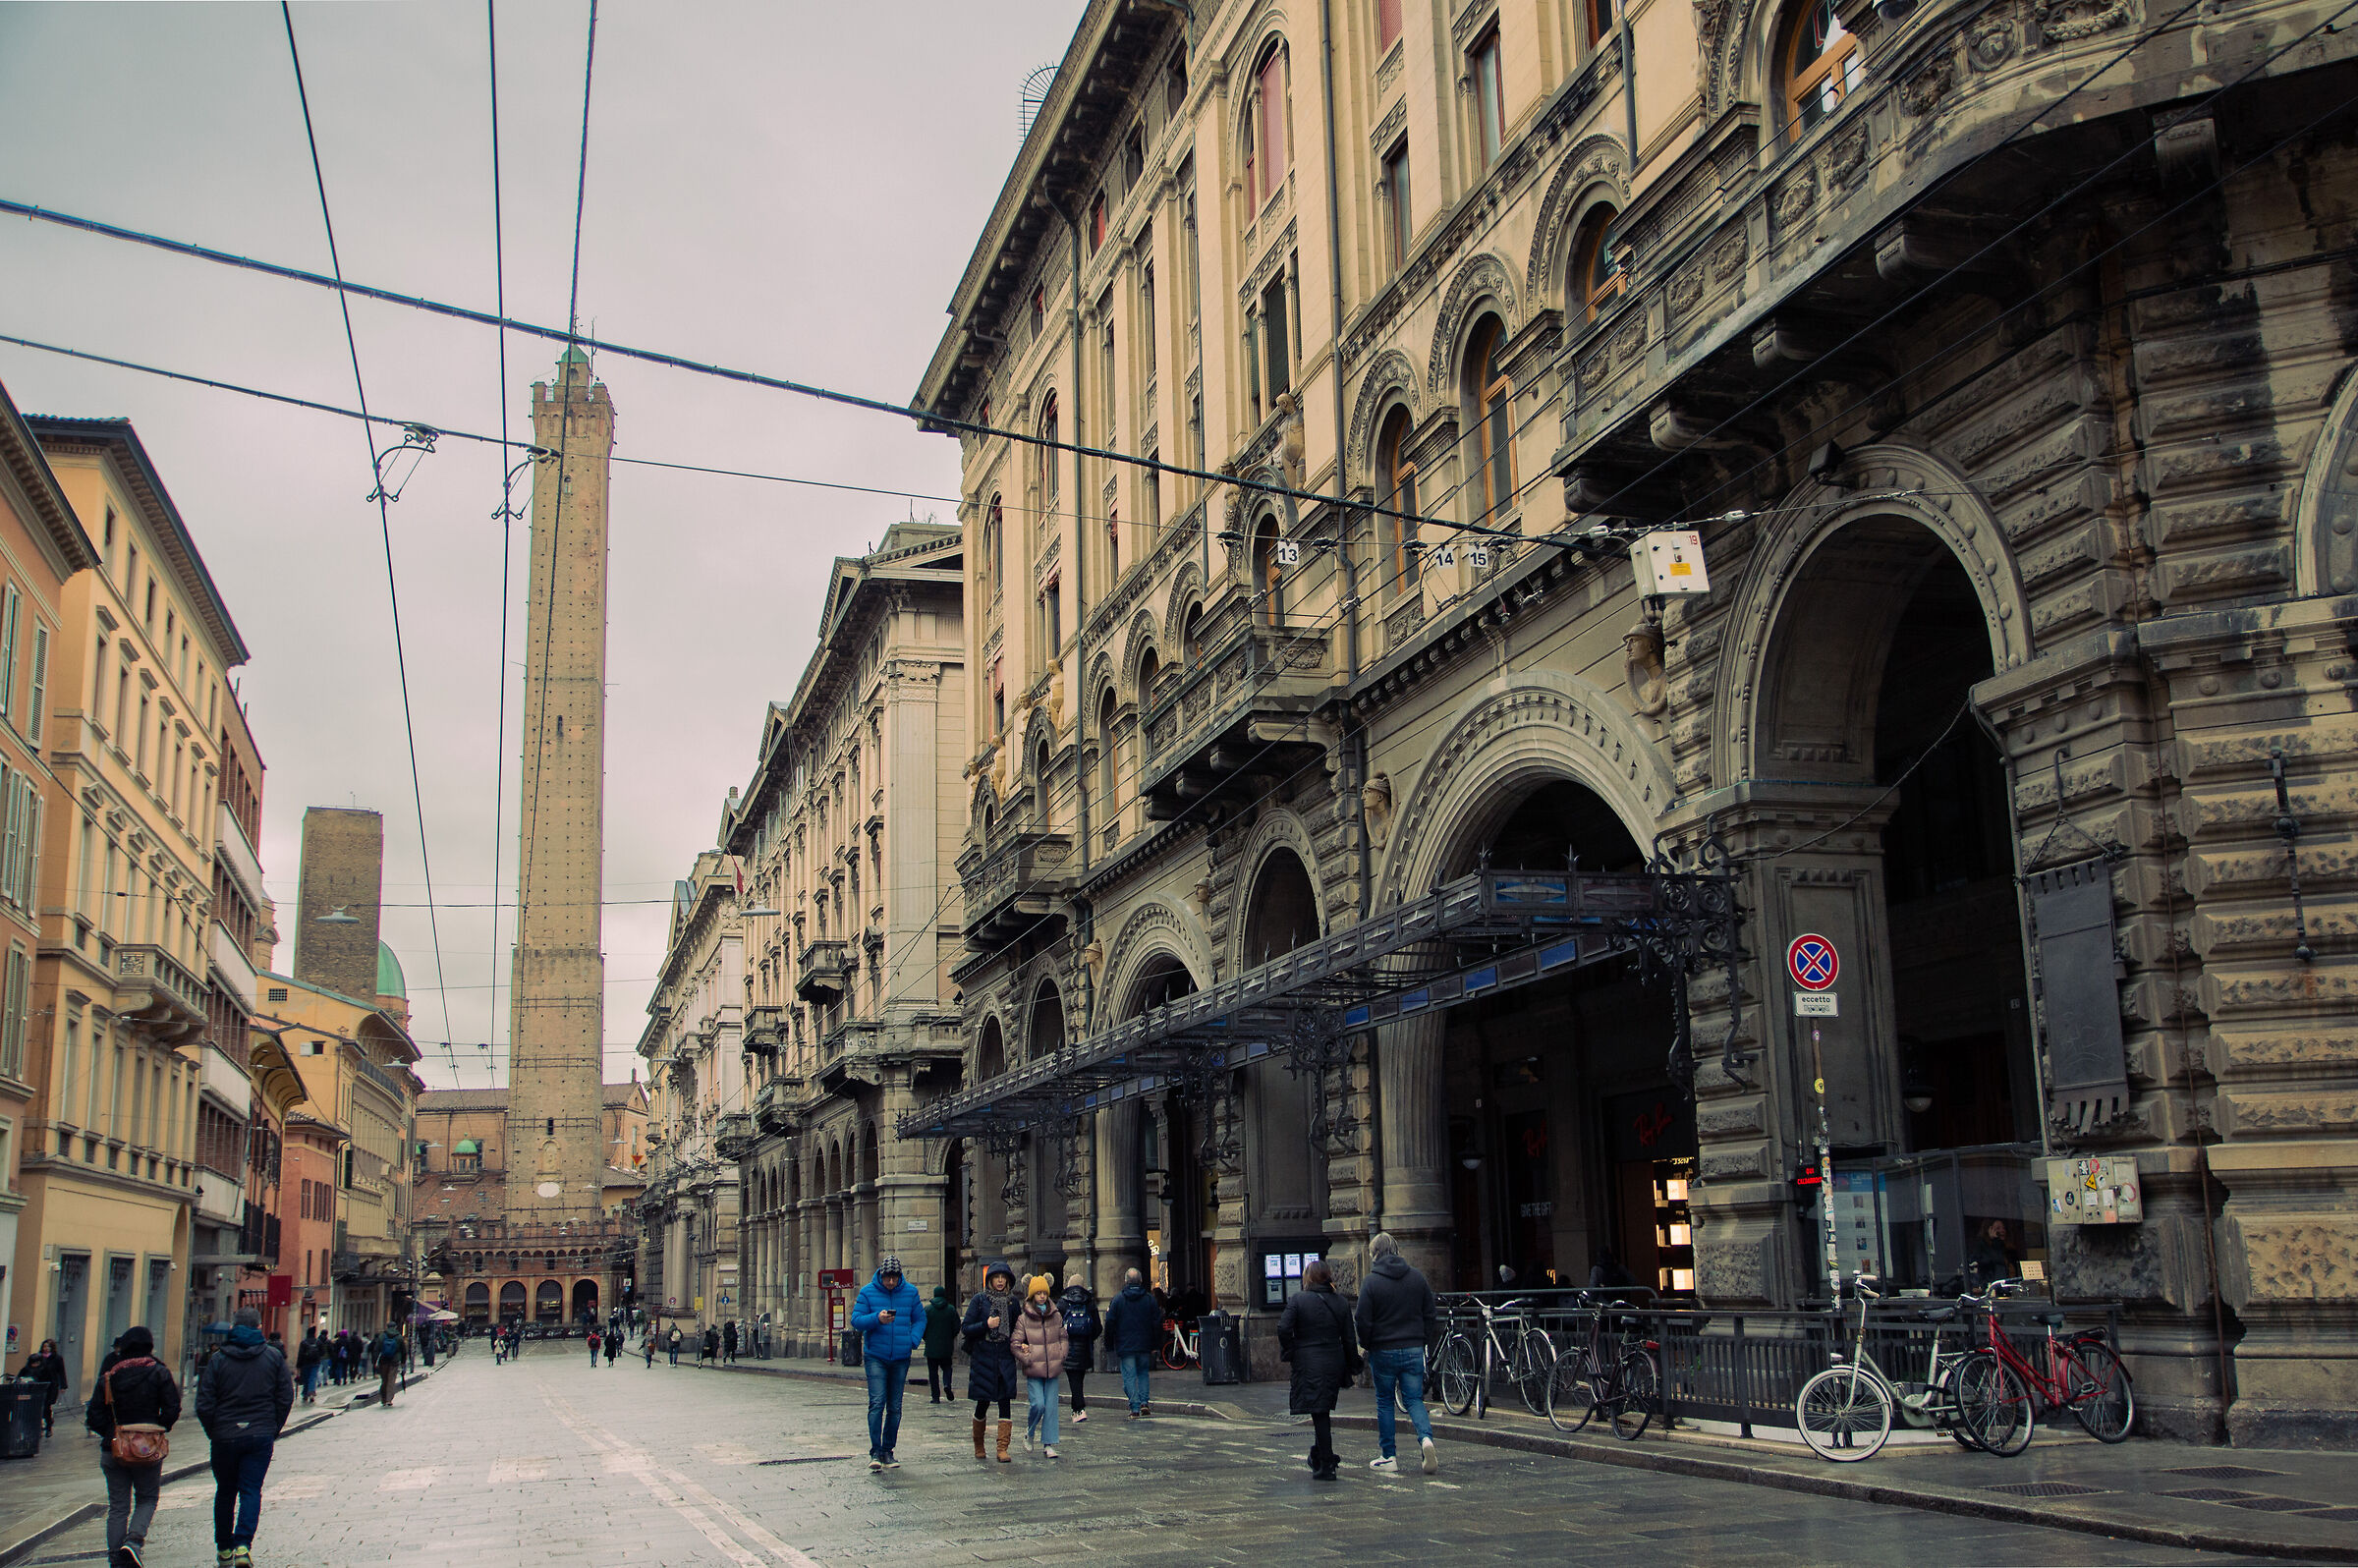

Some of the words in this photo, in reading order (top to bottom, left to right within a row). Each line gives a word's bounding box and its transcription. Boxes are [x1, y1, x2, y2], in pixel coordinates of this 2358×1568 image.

[1689, 534, 1698, 545] 19
[1278, 547, 1298, 562] 13
[1435, 552, 1454, 567] 14
[1470, 551, 1487, 566] 15
[1532, 1203, 1541, 1217] THE
